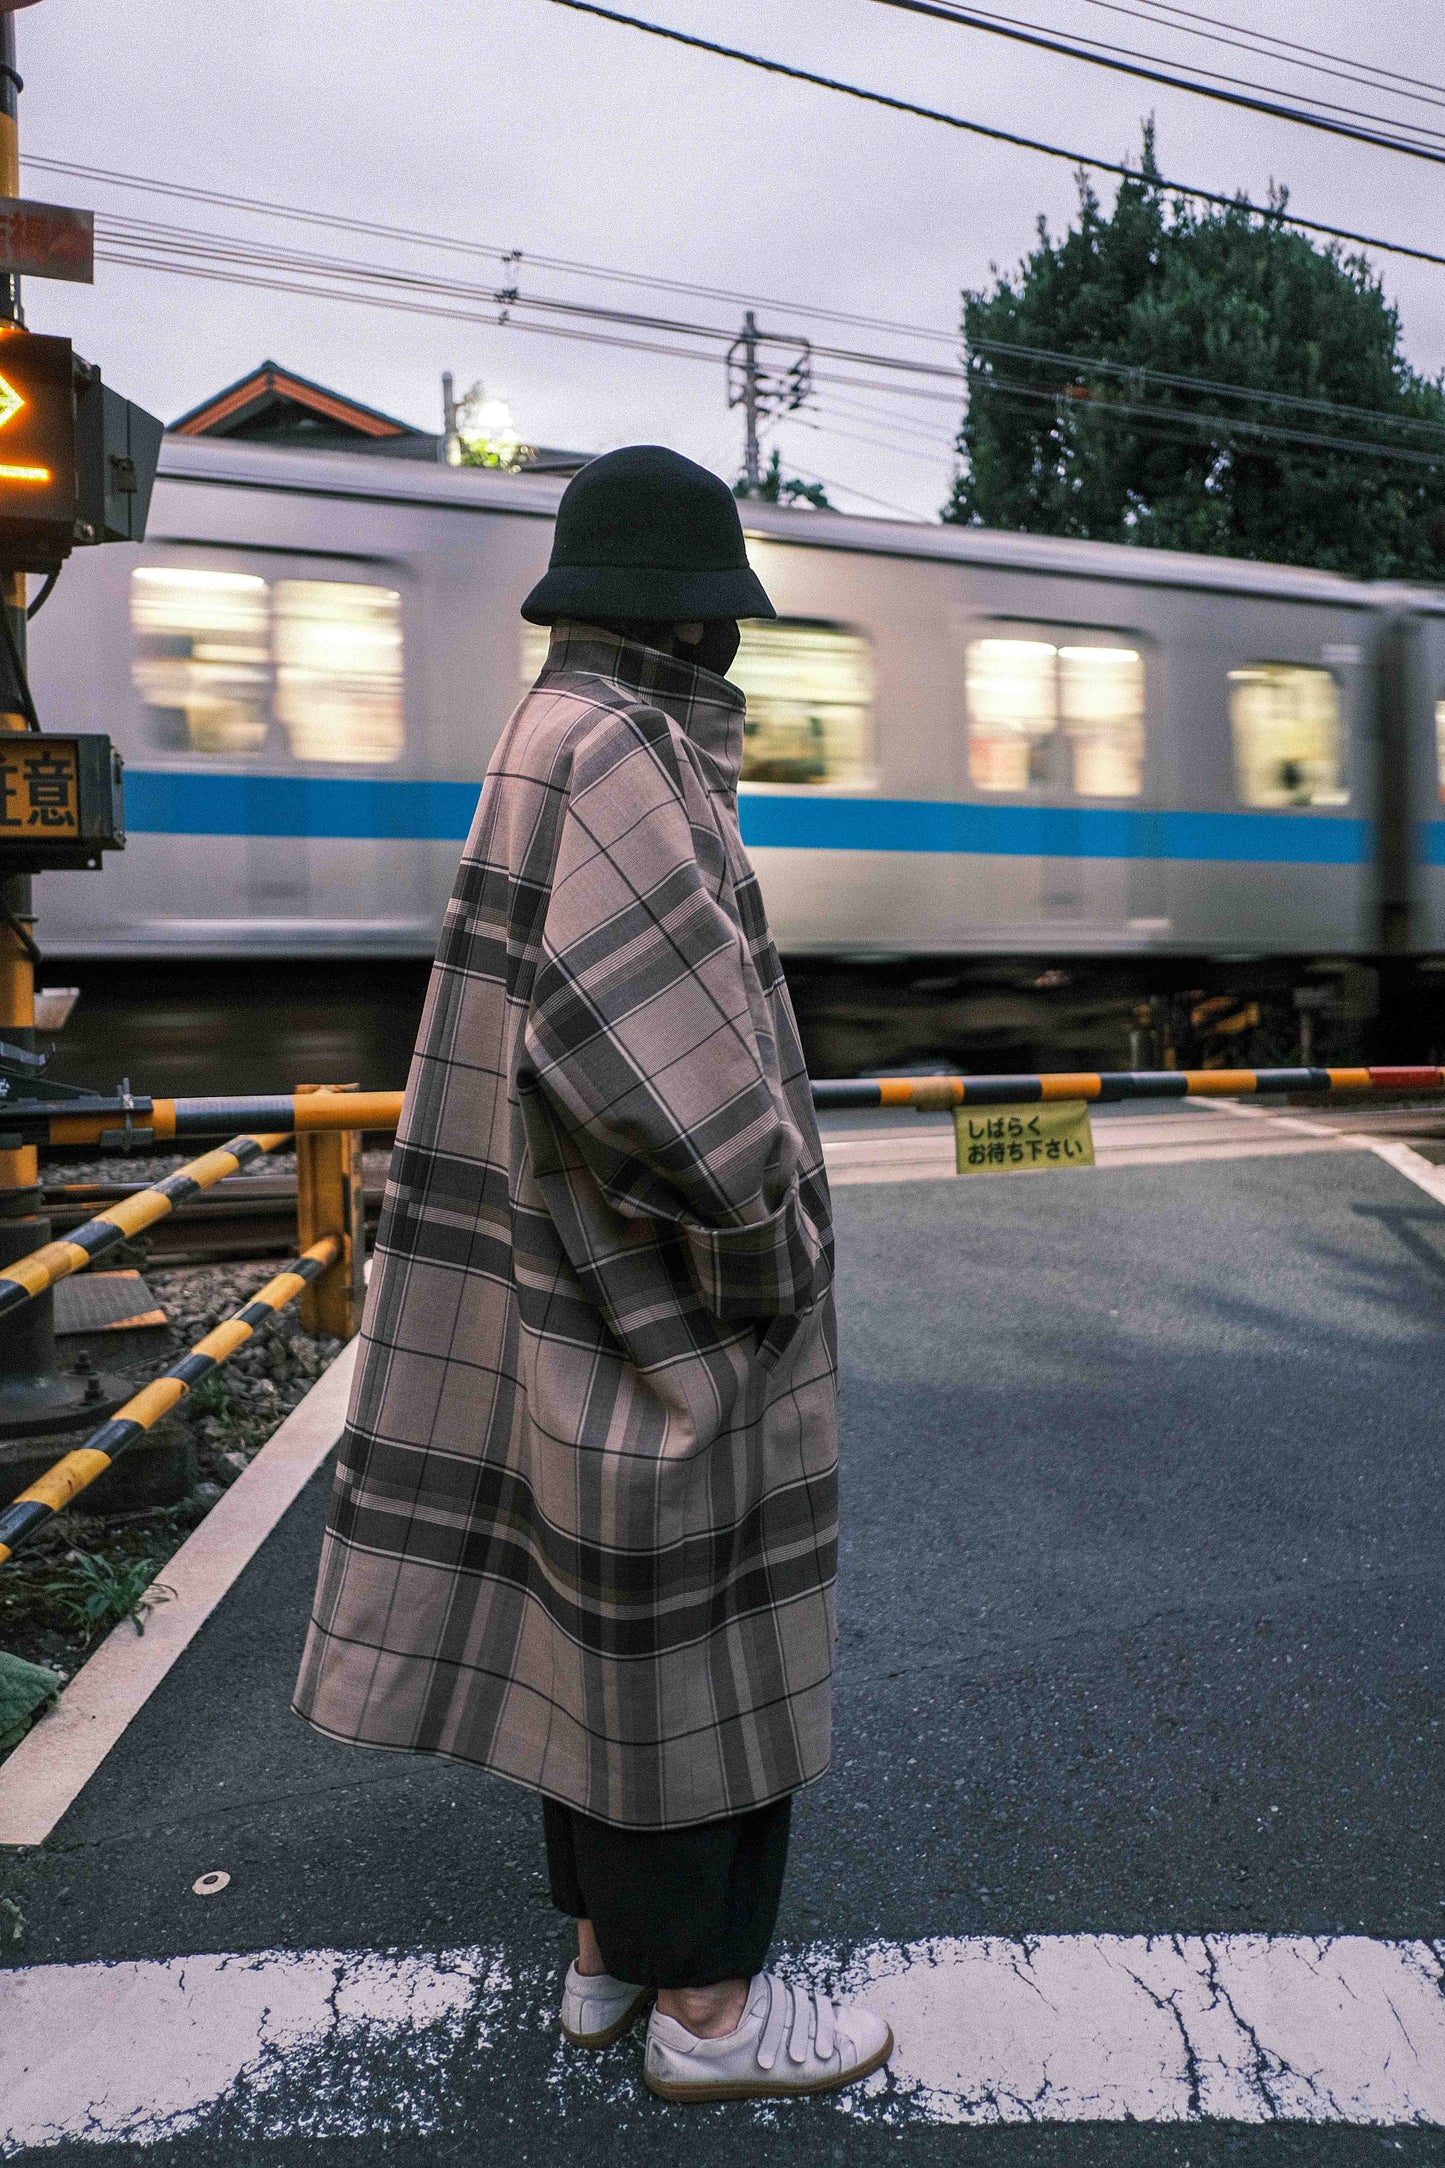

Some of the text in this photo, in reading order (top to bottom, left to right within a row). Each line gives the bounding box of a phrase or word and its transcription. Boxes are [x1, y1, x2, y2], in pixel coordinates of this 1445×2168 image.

[968, 1115, 1041, 1139] しばらく
[967, 1138, 1083, 1165] お待ち下さい
